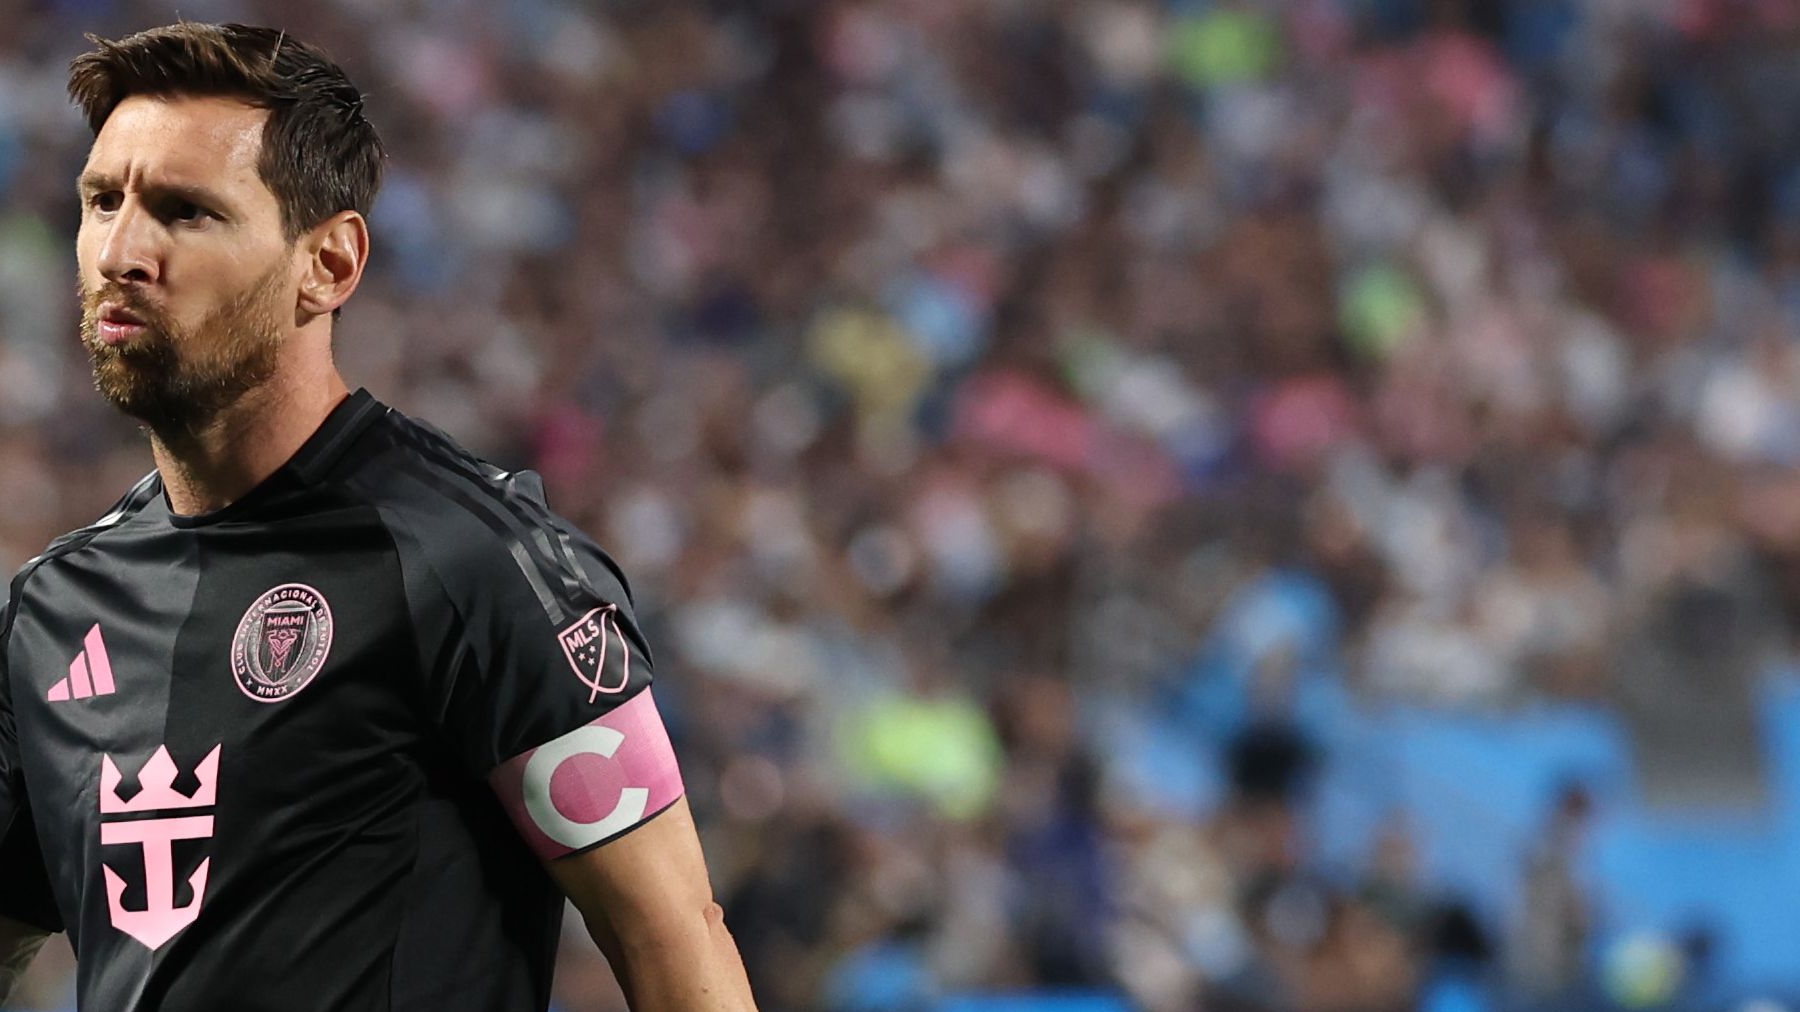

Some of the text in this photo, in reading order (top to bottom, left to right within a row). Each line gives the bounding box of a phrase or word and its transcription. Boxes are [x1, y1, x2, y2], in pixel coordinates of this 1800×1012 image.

[266, 615, 305, 627] MIAMI
[566, 619, 600, 654] MLS
[256, 685, 288, 696] MMXX
[522, 725, 649, 850] C
